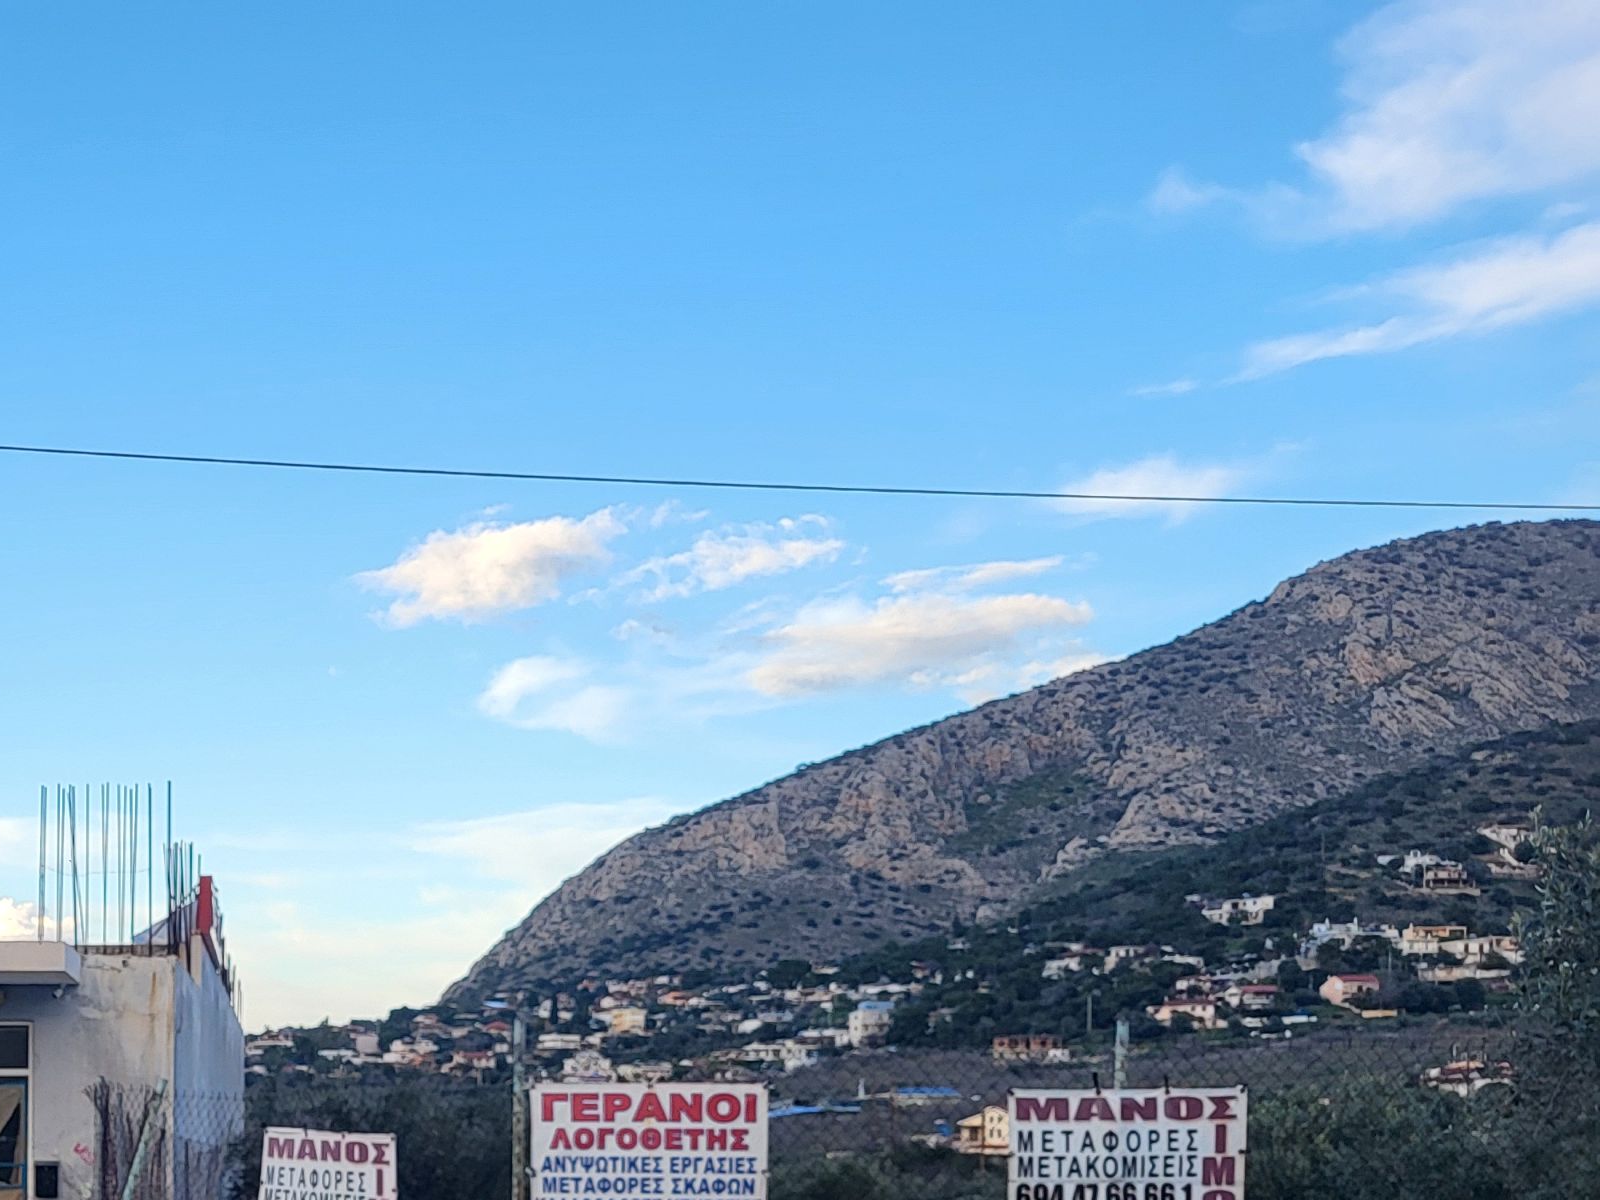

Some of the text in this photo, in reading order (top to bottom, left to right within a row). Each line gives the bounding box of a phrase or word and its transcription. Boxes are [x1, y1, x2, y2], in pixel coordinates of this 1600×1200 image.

[541, 1092, 758, 1123] ΓΕΡΑΝΟΙ
[1015, 1096, 1238, 1121] ΜΑΝΟΣ
[550, 1127, 749, 1151] ΛΟΓΟΘΕΤΗΣ
[1017, 1129, 1199, 1152] ΜΕΤΑΦΟΡΕΣ
[267, 1137, 390, 1166] ΜΑΝΟΣ
[540, 1156, 758, 1174] ΑΝΥΨΩΤΙΚΕΣ ΕΡΓΑΣΙΕΣ
[1017, 1155, 1199, 1179] ΜΕΤΑΚΟΜΙΣΕΙΣ
[266, 1165, 366, 1193] ΜΕΤΑΦΟΡΕΣ
[542, 1177, 755, 1195] ΜΕΤΑΦΟΡΕΣ ΣΚΑΦΩΝ
